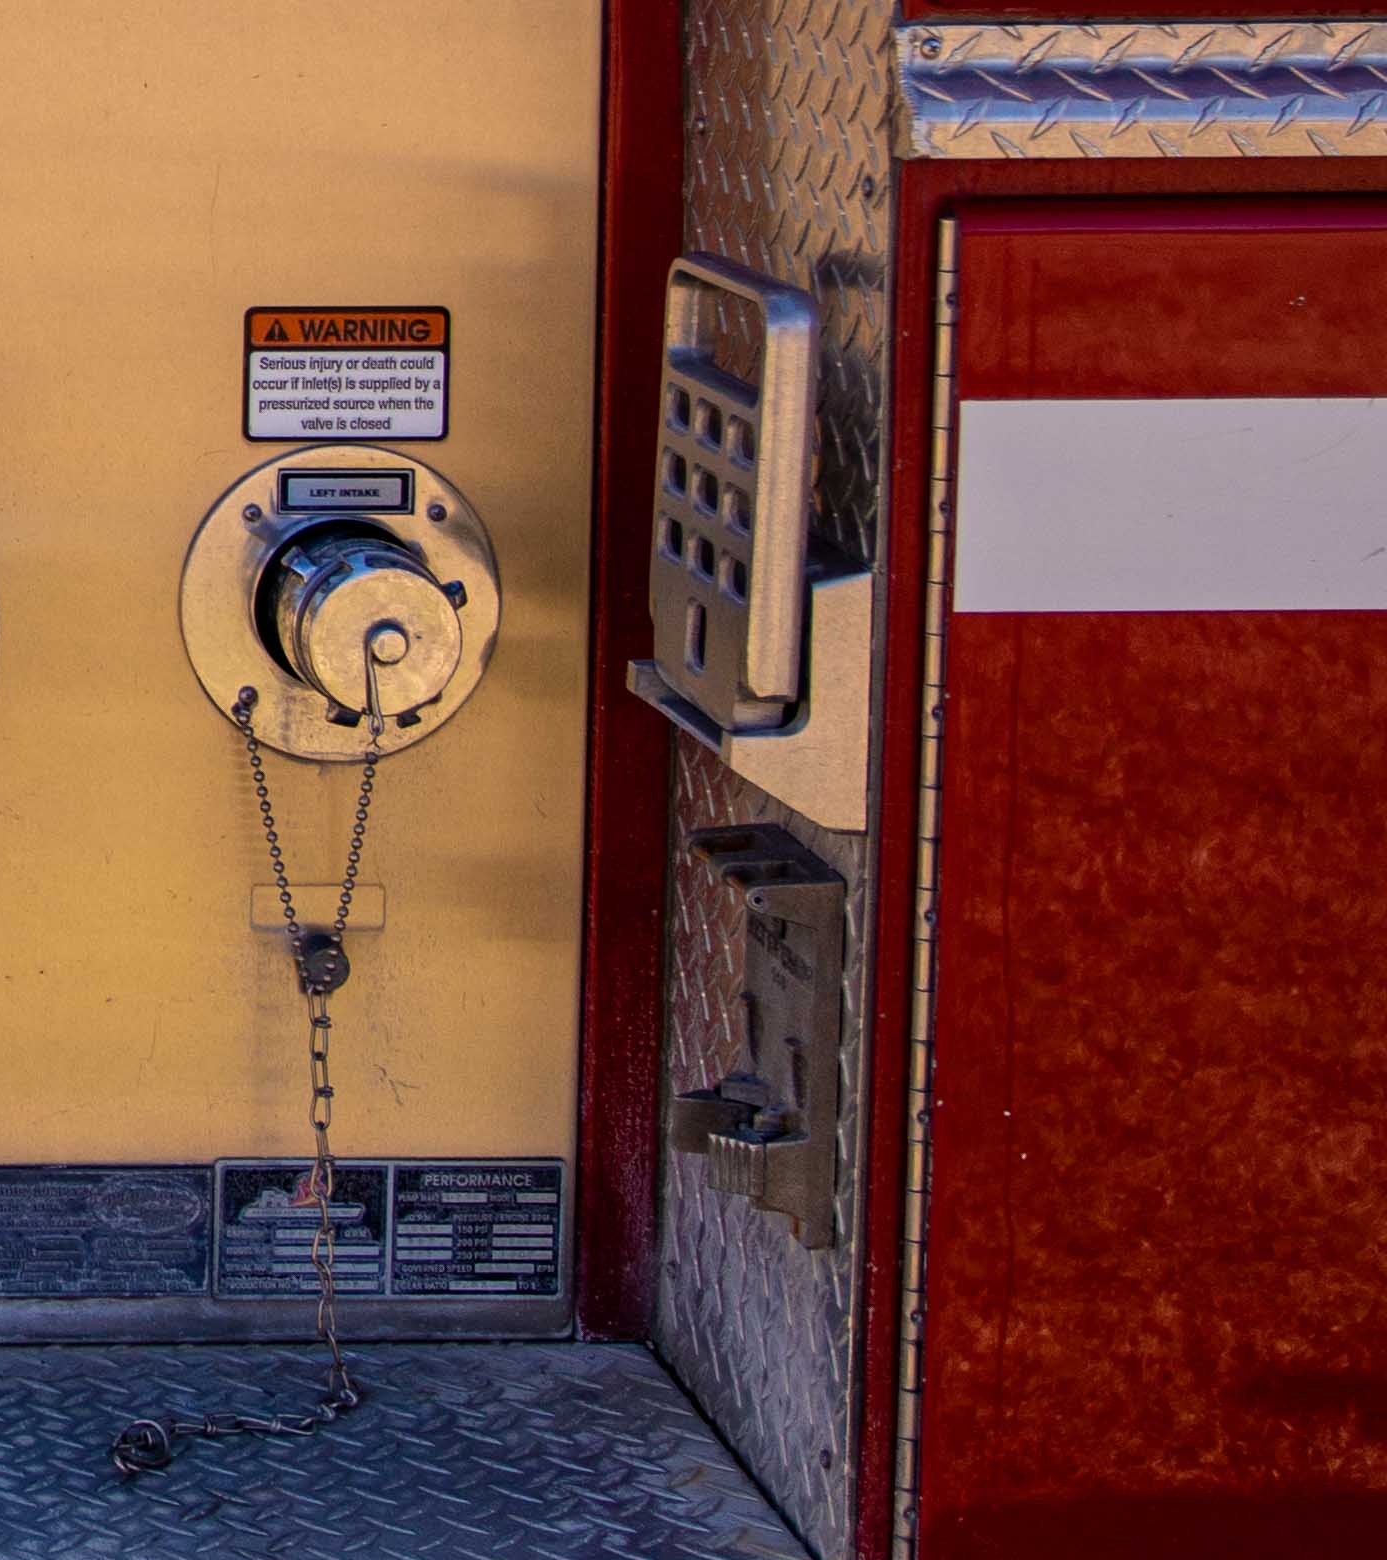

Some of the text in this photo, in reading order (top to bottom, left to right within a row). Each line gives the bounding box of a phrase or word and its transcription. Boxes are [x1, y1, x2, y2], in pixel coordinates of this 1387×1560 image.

[299, 318, 431, 343] WARNING
[259, 356, 435, 374] Serious injury or death could
[252, 376, 442, 395] occur if inlet(s) is supplied by a
[258, 396, 434, 413] pressurized source when the
[301, 417, 392, 431] valve is closed
[309, 488, 380, 498] LEFT INTAKE
[424, 1174, 532, 1186] PERFORMANCE
